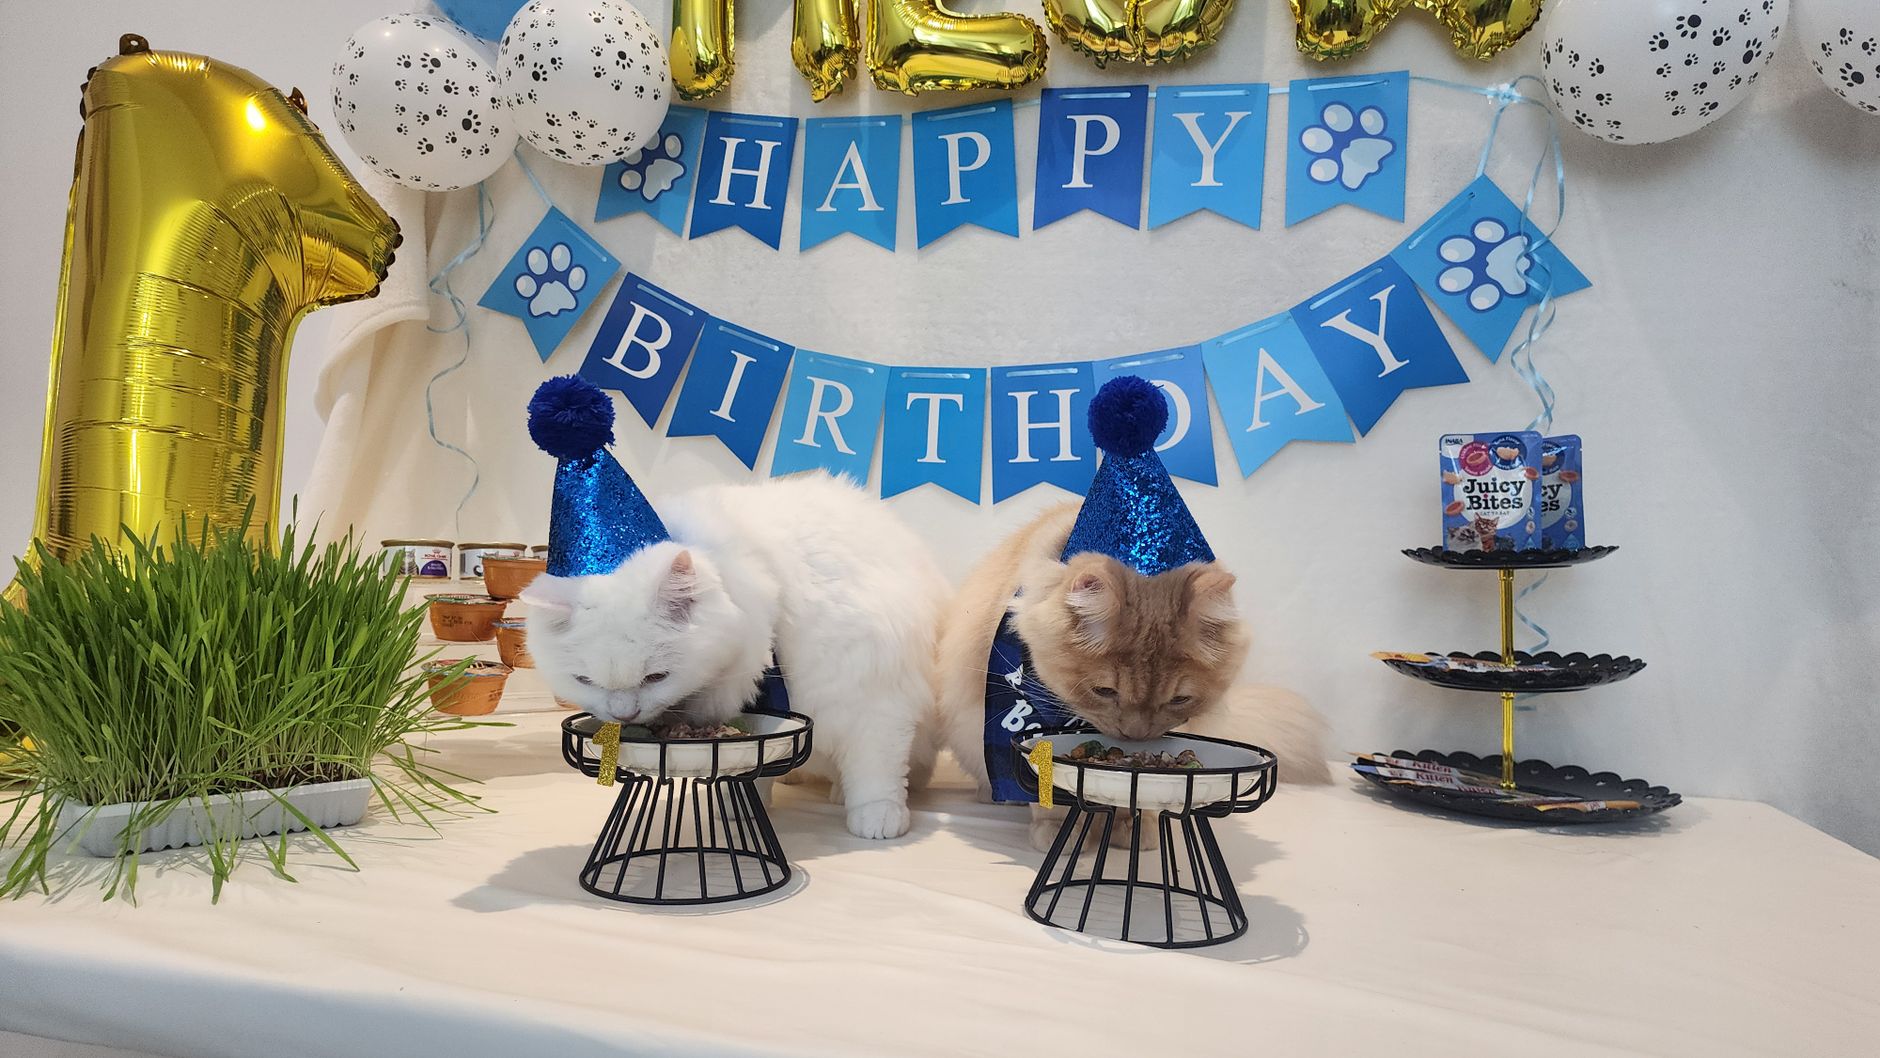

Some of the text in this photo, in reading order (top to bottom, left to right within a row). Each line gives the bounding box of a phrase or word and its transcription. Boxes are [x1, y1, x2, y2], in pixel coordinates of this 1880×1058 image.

[708, 111, 1253, 213] HAPPY
[1463, 477, 1525, 496] Juicy
[1466, 494, 1523, 511] Bites
[1028, 740, 1053, 809] 1
[1412, 761, 1452, 774] Kitten
[1416, 771, 1454, 784] Kitten
